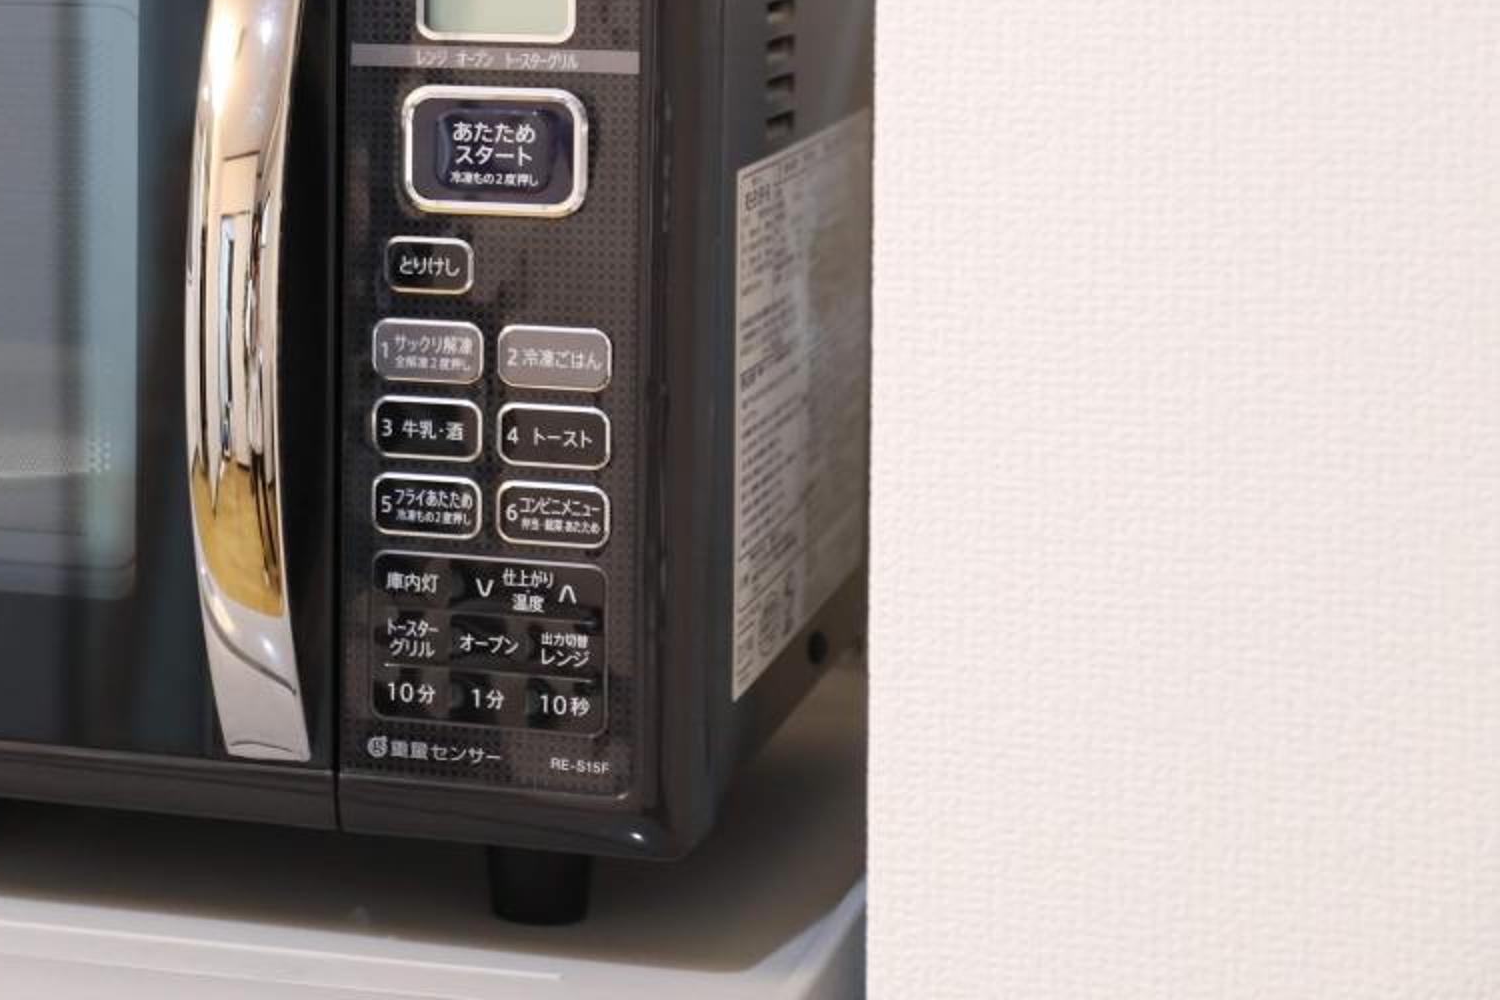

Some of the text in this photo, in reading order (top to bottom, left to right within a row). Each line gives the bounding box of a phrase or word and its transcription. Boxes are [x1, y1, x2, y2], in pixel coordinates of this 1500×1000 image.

[452, 121, 535, 144] あたため
[455, 145, 533, 167] スタート
[399, 256, 460, 277] とりけし
[381, 341, 389, 359] 1
[507, 348, 603, 370] 2 冷凍ごはん
[381, 421, 393, 437] 3
[507, 427, 593, 449] 4 トースト
[381, 489, 473, 513] 5 フライあたため
[506, 497, 601, 522] 6 コンビニメニュー
[386, 572, 439, 594] 庫内灯
[502, 568, 555, 590] 仕上がり
[512, 593, 545, 614] 温度
[387, 618, 439, 639] トースター
[389, 638, 436, 660] グリル
[459, 633, 519, 656] オープン
[541, 649, 589, 668] レンジ
